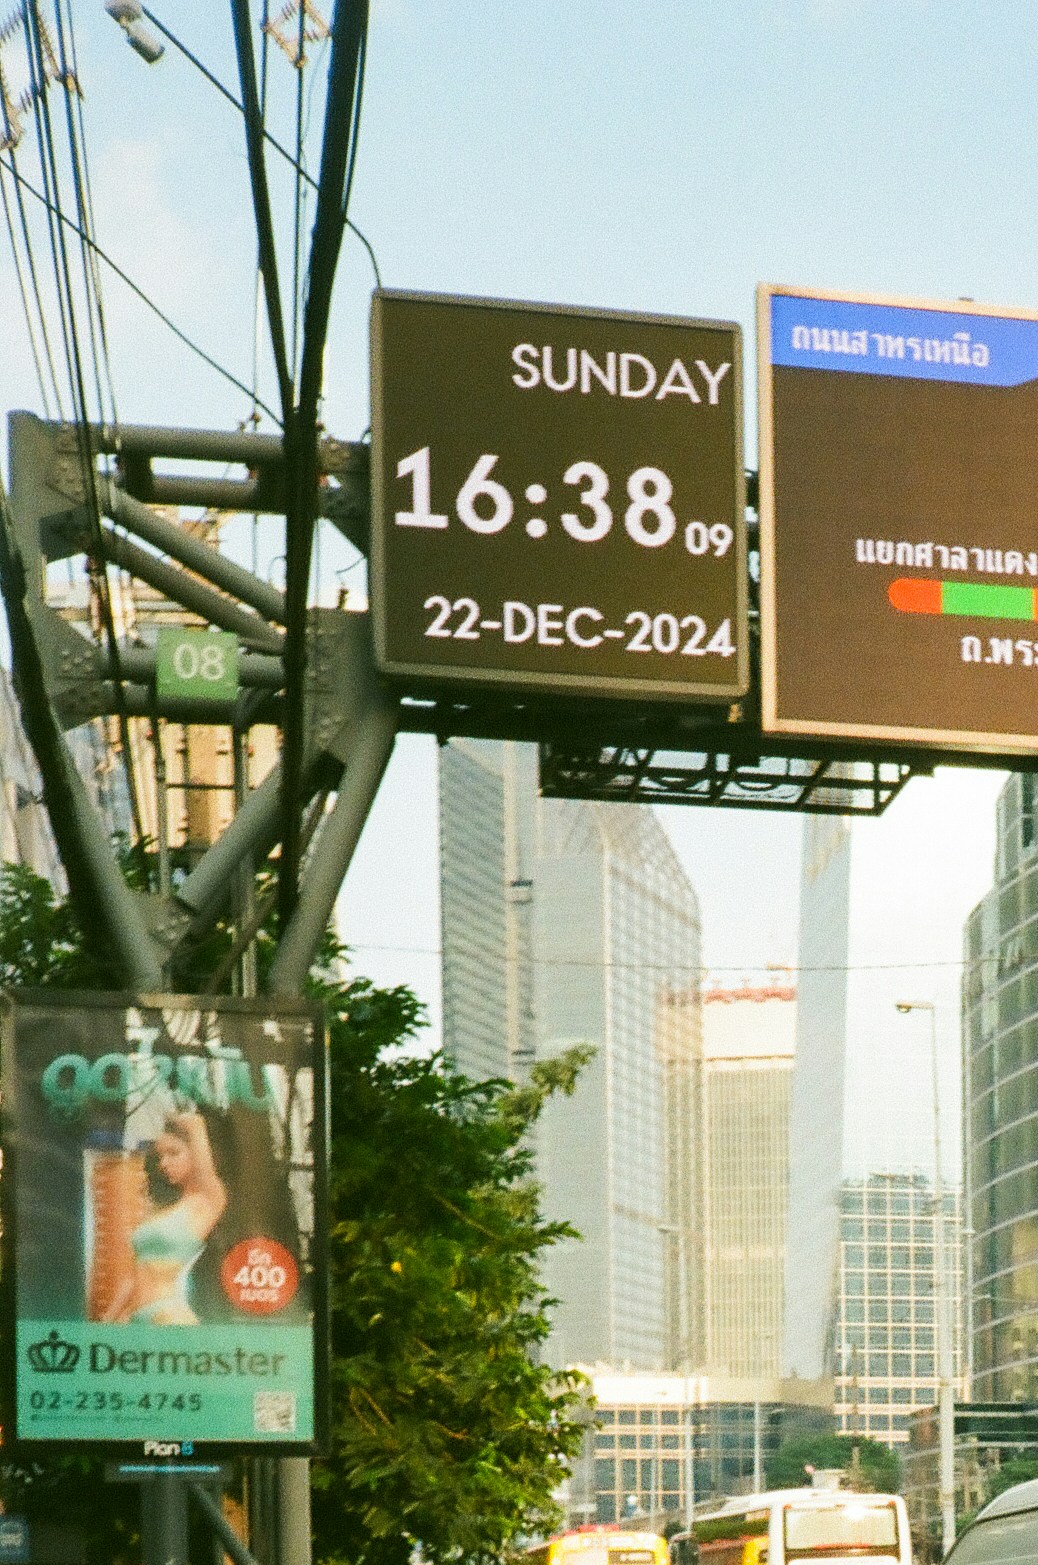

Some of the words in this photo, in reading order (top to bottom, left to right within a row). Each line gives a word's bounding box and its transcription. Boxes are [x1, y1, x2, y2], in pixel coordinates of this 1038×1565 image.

[791, 324, 991, 369] ถนนสาทรเหนือ
[511, 343, 732, 405] SUNDAY
[395, 447, 677, 548] 16:38
[684, 521, 734, 557] 09
[423, 594, 737, 658] 22-DEC-2024
[173, 643, 225, 680] 08
[233, 1265, 287, 1289] 400
[88, 1342, 288, 1377] Dermaster
[29, 1389, 202, 1413] 02-235-4745
